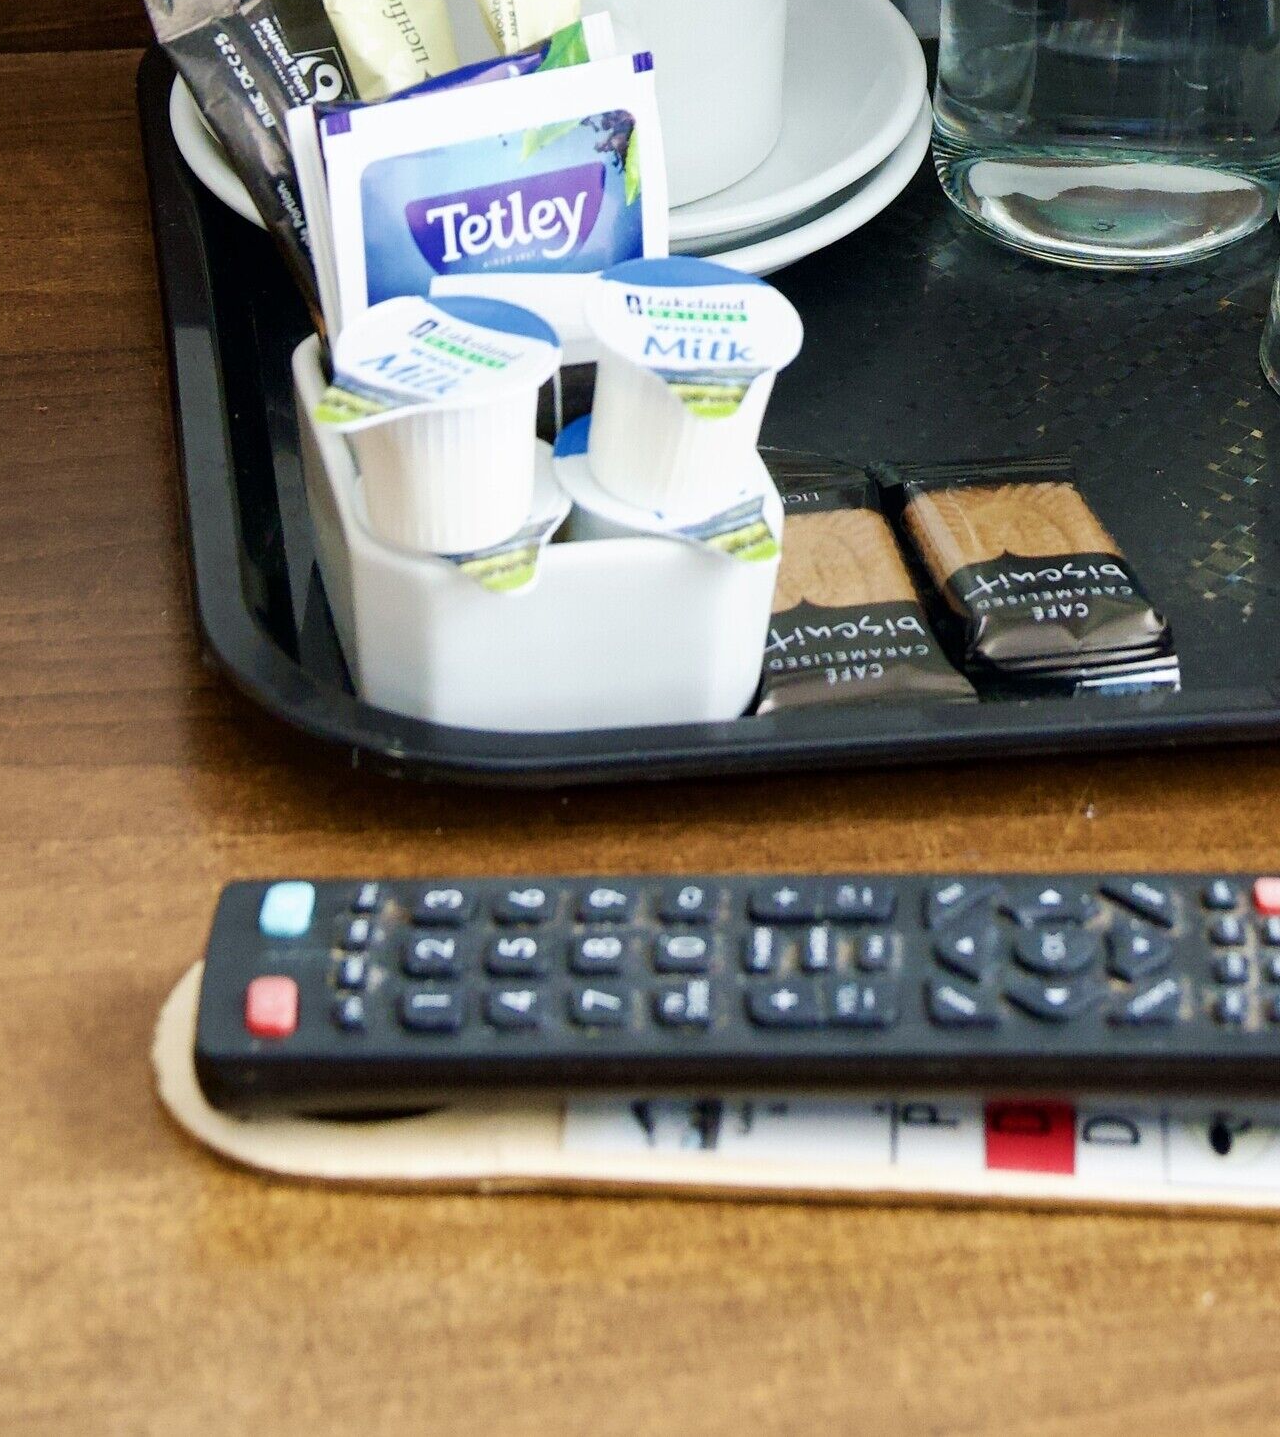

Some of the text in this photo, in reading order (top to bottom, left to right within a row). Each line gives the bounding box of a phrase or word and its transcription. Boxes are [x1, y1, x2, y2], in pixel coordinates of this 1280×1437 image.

[426, 189, 588, 264] Tetley
[642, 336, 756, 361] Milk
[963, 562, 1129, 602] biscuit
[976, 585, 1133, 611] CARAMELISED
[763, 615, 927, 655] biscuit
[770, 644, 929, 671] CARAMELISED
[423, 888, 464, 909] 3
[507, 888, 546, 908] 6
[414, 937, 456, 960] 2
[497, 936, 538, 960] 5
[581, 888, 627, 1011] 7 8 9
